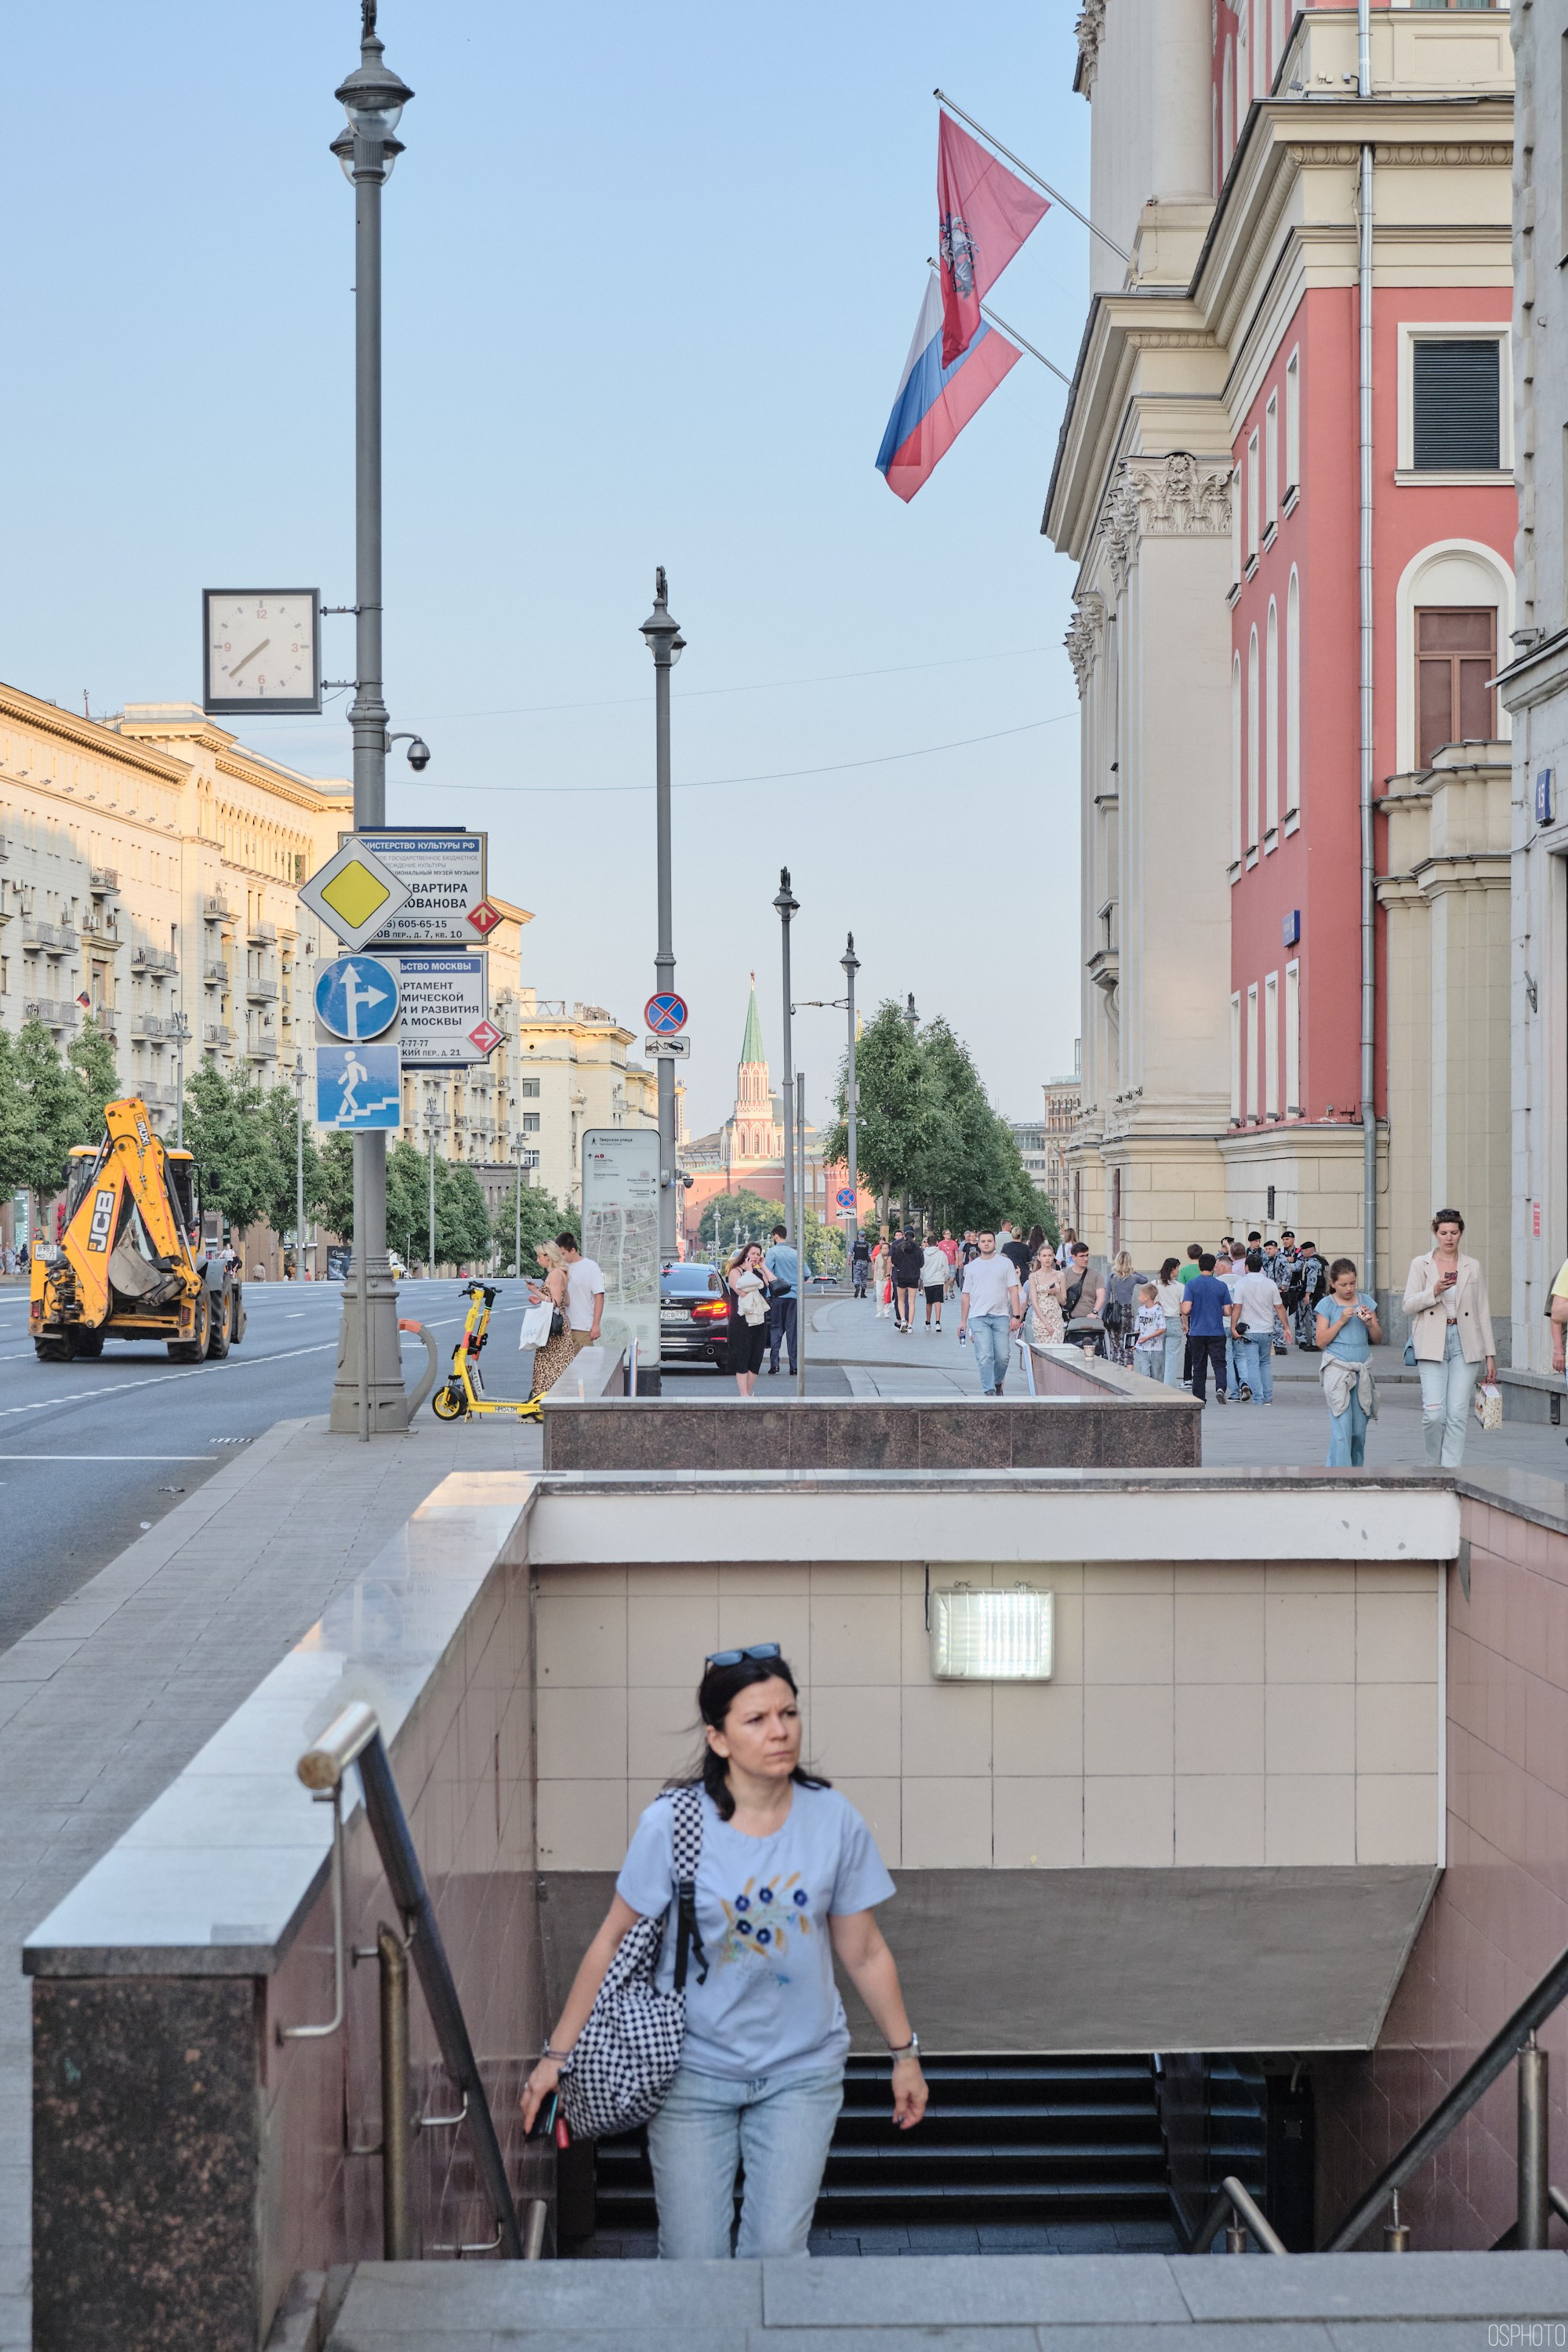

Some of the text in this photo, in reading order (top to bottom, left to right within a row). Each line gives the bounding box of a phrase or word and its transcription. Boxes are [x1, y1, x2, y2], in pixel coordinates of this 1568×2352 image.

[256, 610, 267, 619] 12
[224, 642, 231, 652] 9
[291, 643, 298, 653] 3
[258, 675, 265, 684] 6
[408, 884, 468, 893] ВАРТИРА
[405, 898, 467, 908] ОВАНОВА
[450, 930, 463, 938] 10
[401, 992, 464, 1002] МИЧЕСКОЙ
[401, 1047, 420, 1056] КИЙ
[90, 1192, 114, 1251] JCB
